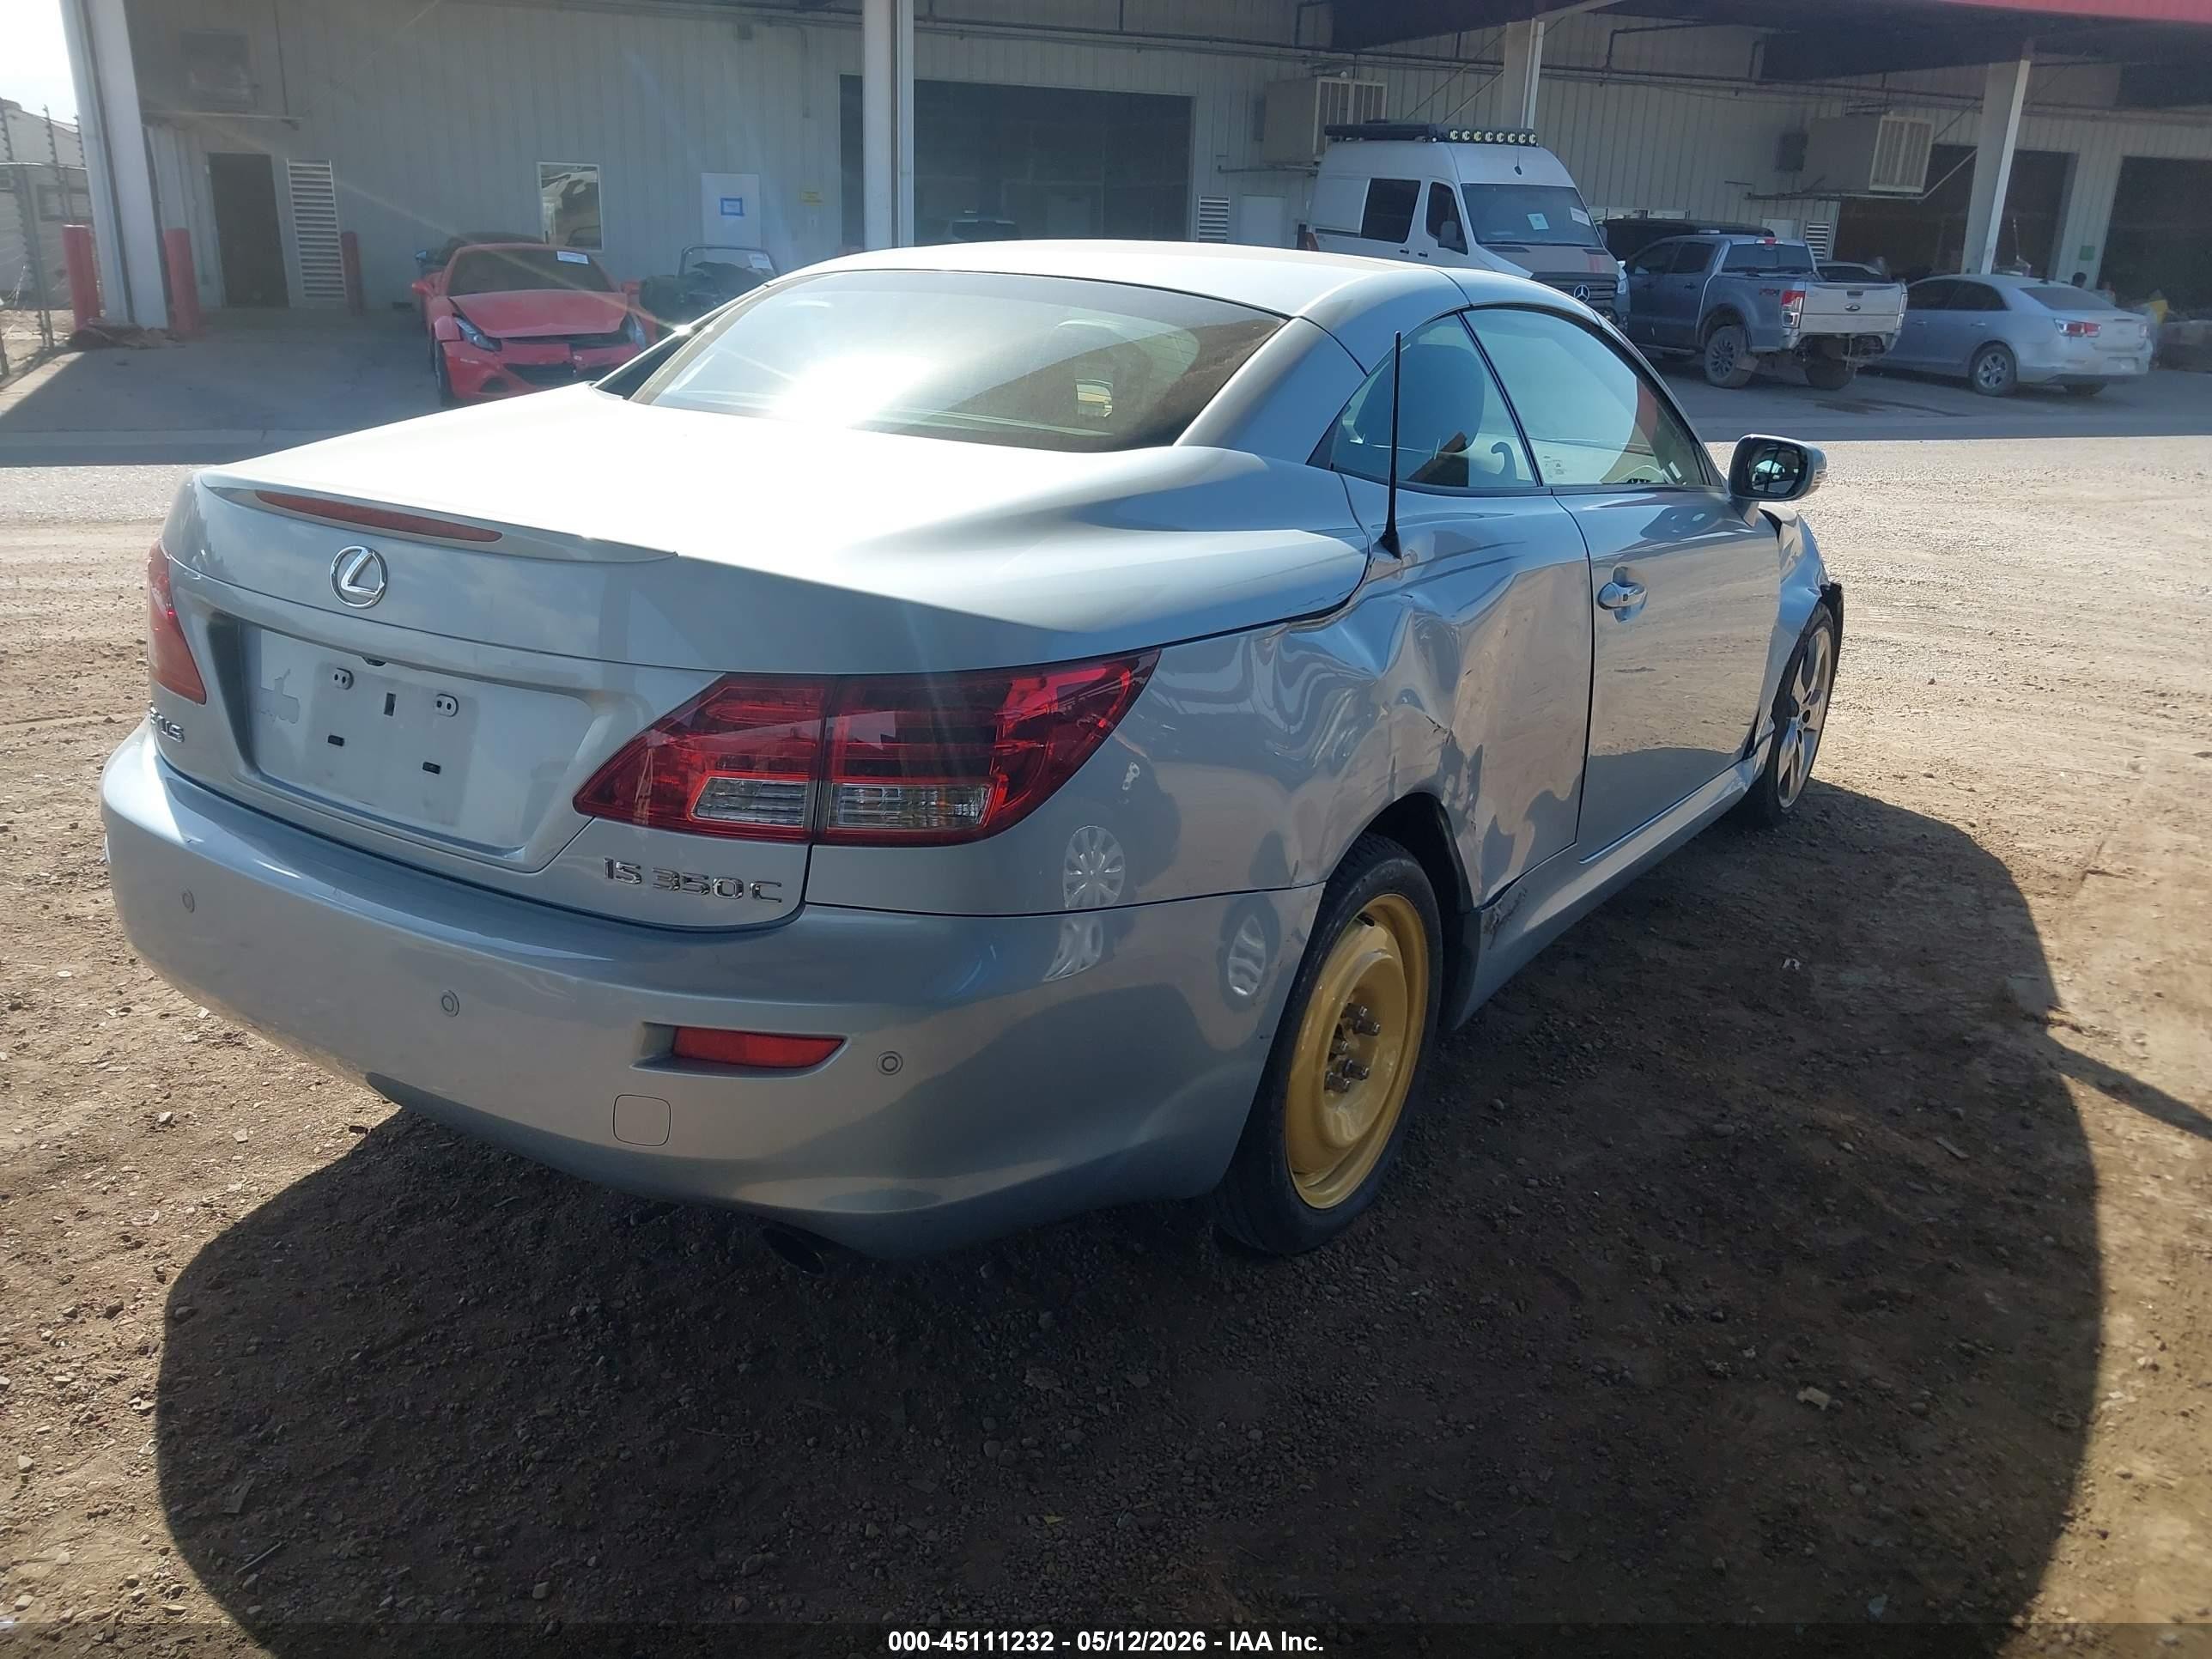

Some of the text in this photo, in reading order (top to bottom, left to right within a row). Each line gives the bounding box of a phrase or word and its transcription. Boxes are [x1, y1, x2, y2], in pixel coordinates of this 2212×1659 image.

[603, 857, 782, 903] IS 350 C
